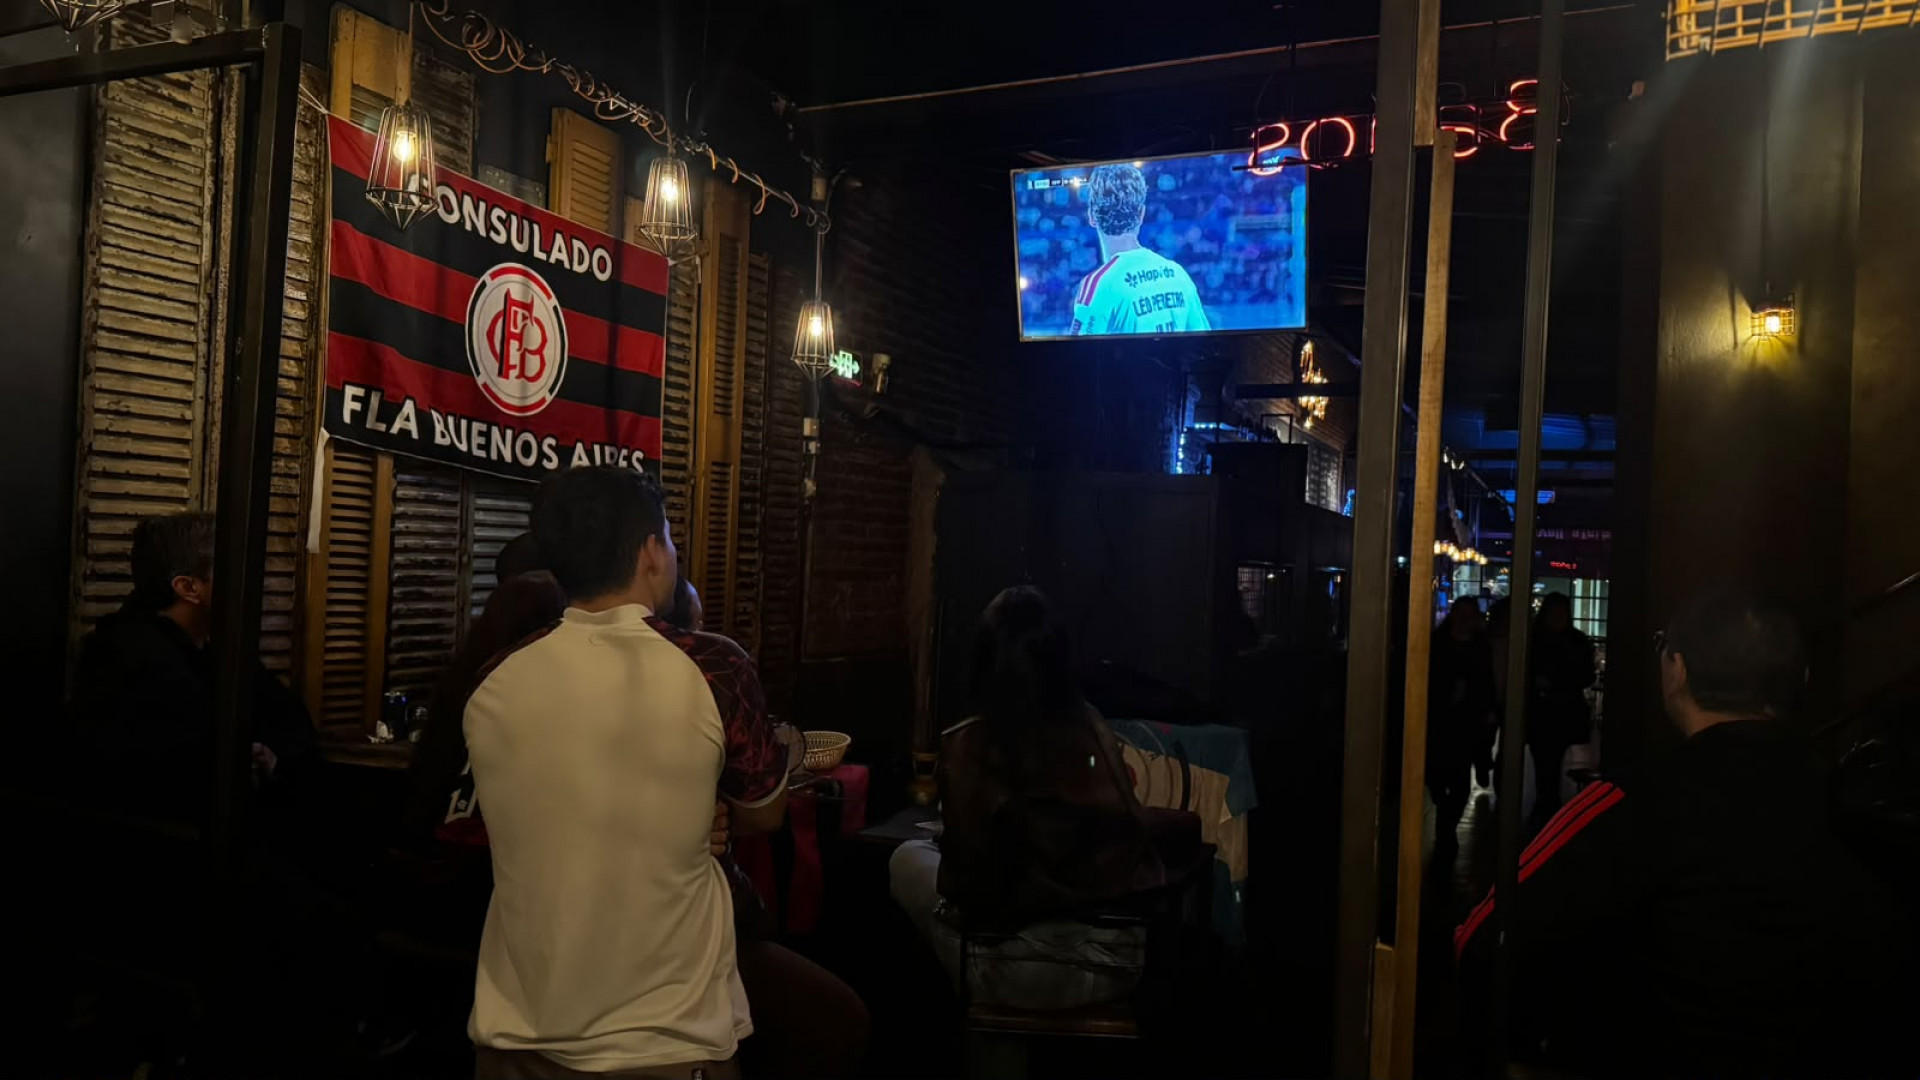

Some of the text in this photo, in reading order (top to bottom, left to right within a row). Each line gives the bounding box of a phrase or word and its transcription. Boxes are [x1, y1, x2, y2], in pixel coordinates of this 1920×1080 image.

[407, 173, 613, 282] CONSULADO
[342, 384, 419, 440] FLA
[430, 407, 559, 470] BUENOS
